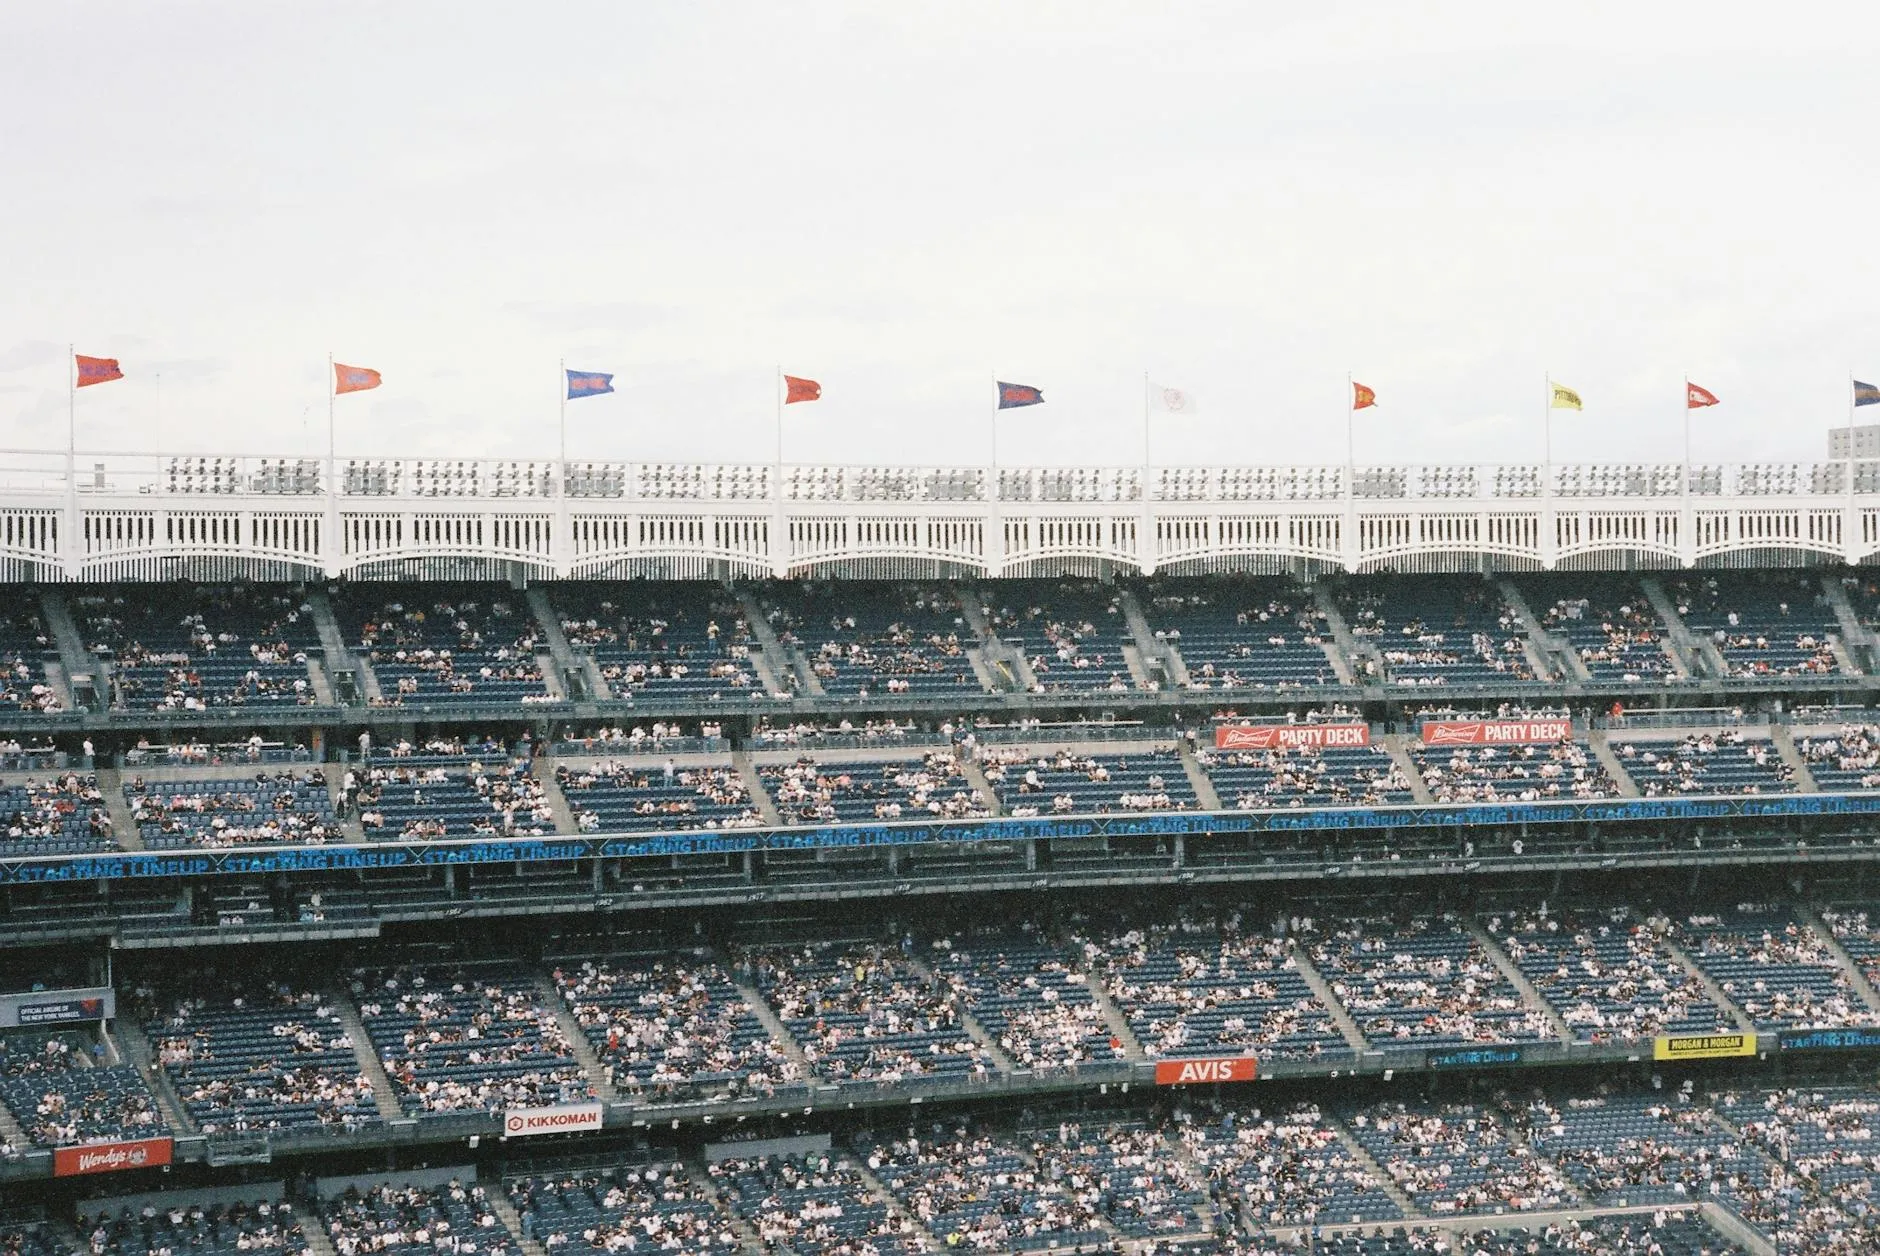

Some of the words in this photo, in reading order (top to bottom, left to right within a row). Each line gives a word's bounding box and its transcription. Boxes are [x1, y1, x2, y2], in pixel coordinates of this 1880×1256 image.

[1228, 731, 1268, 743] Budweiser
[1279, 728, 1324, 744] PARTY
[1326, 728, 1364, 744] DECK
[1434, 727, 1476, 738] Budweiser
[1484, 724, 1530, 740] PARTY
[1530, 723, 1566, 740] DECK
[1585, 806, 1666, 819] STARTING
[1673, 804, 1728, 816] LINEUP
[1743, 802, 1824, 814] STARTING
[1270, 816, 1350, 829] STARTING
[1356, 814, 1408, 826] LINEUP
[1423, 811, 1507, 824] STARTING
[1512, 809, 1572, 821] LINEUP
[942, 827, 1024, 840] STARTING
[1030, 824, 1091, 837] LINEUP
[1108, 821, 1187, 834] STARTING
[1194, 819, 1250, 831] LINEUP
[605, 840, 690, 855] STARTING
[697, 837, 756, 851] LINEUP
[771, 833, 858, 848] STARTING
[865, 830, 927, 844] LINEUP
[225, 855, 325, 871] STARTING
[333, 851, 406, 867] LINEUP
[424, 847, 514, 863] STARTING
[521, 844, 584, 858] LINEUP
[19, 864, 121, 881] STARTING
[129, 860, 207, 876] LINEUP
[1672, 1038, 1702, 1050] MORGAN
[1702, 1038, 1708, 1048] &
[1710, 1036, 1740, 1048] MORGAN
[1179, 1061, 1233, 1080] AVIS
[528, 1112, 596, 1127] KIKKOMAN
[80, 1148, 126, 1170] Wendy's
